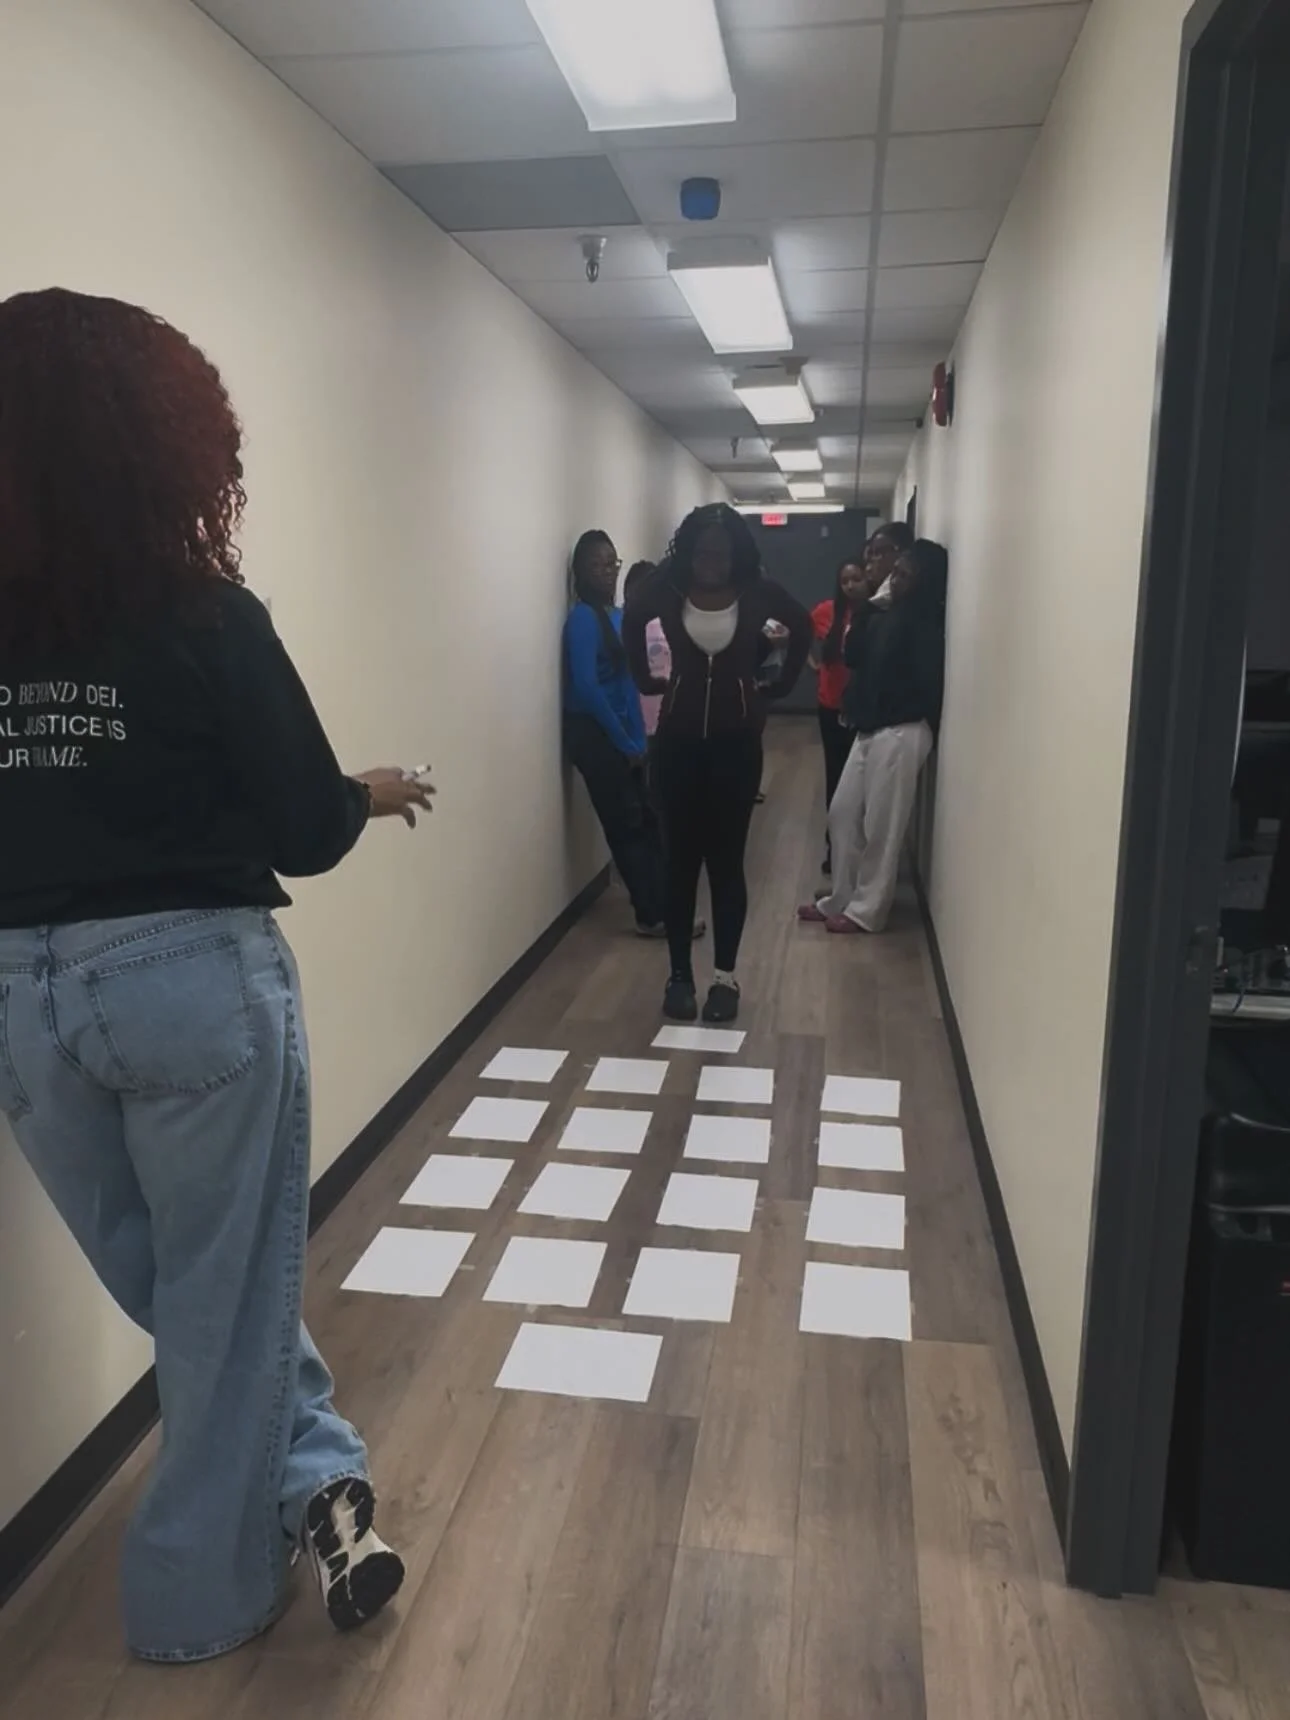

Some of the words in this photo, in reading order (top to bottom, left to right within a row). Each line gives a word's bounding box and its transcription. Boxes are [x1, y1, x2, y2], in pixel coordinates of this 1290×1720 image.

[86, 684, 124, 708] DEI.
[24, 715, 104, 736] JUSTICE
[106, 719, 127, 741] IS
